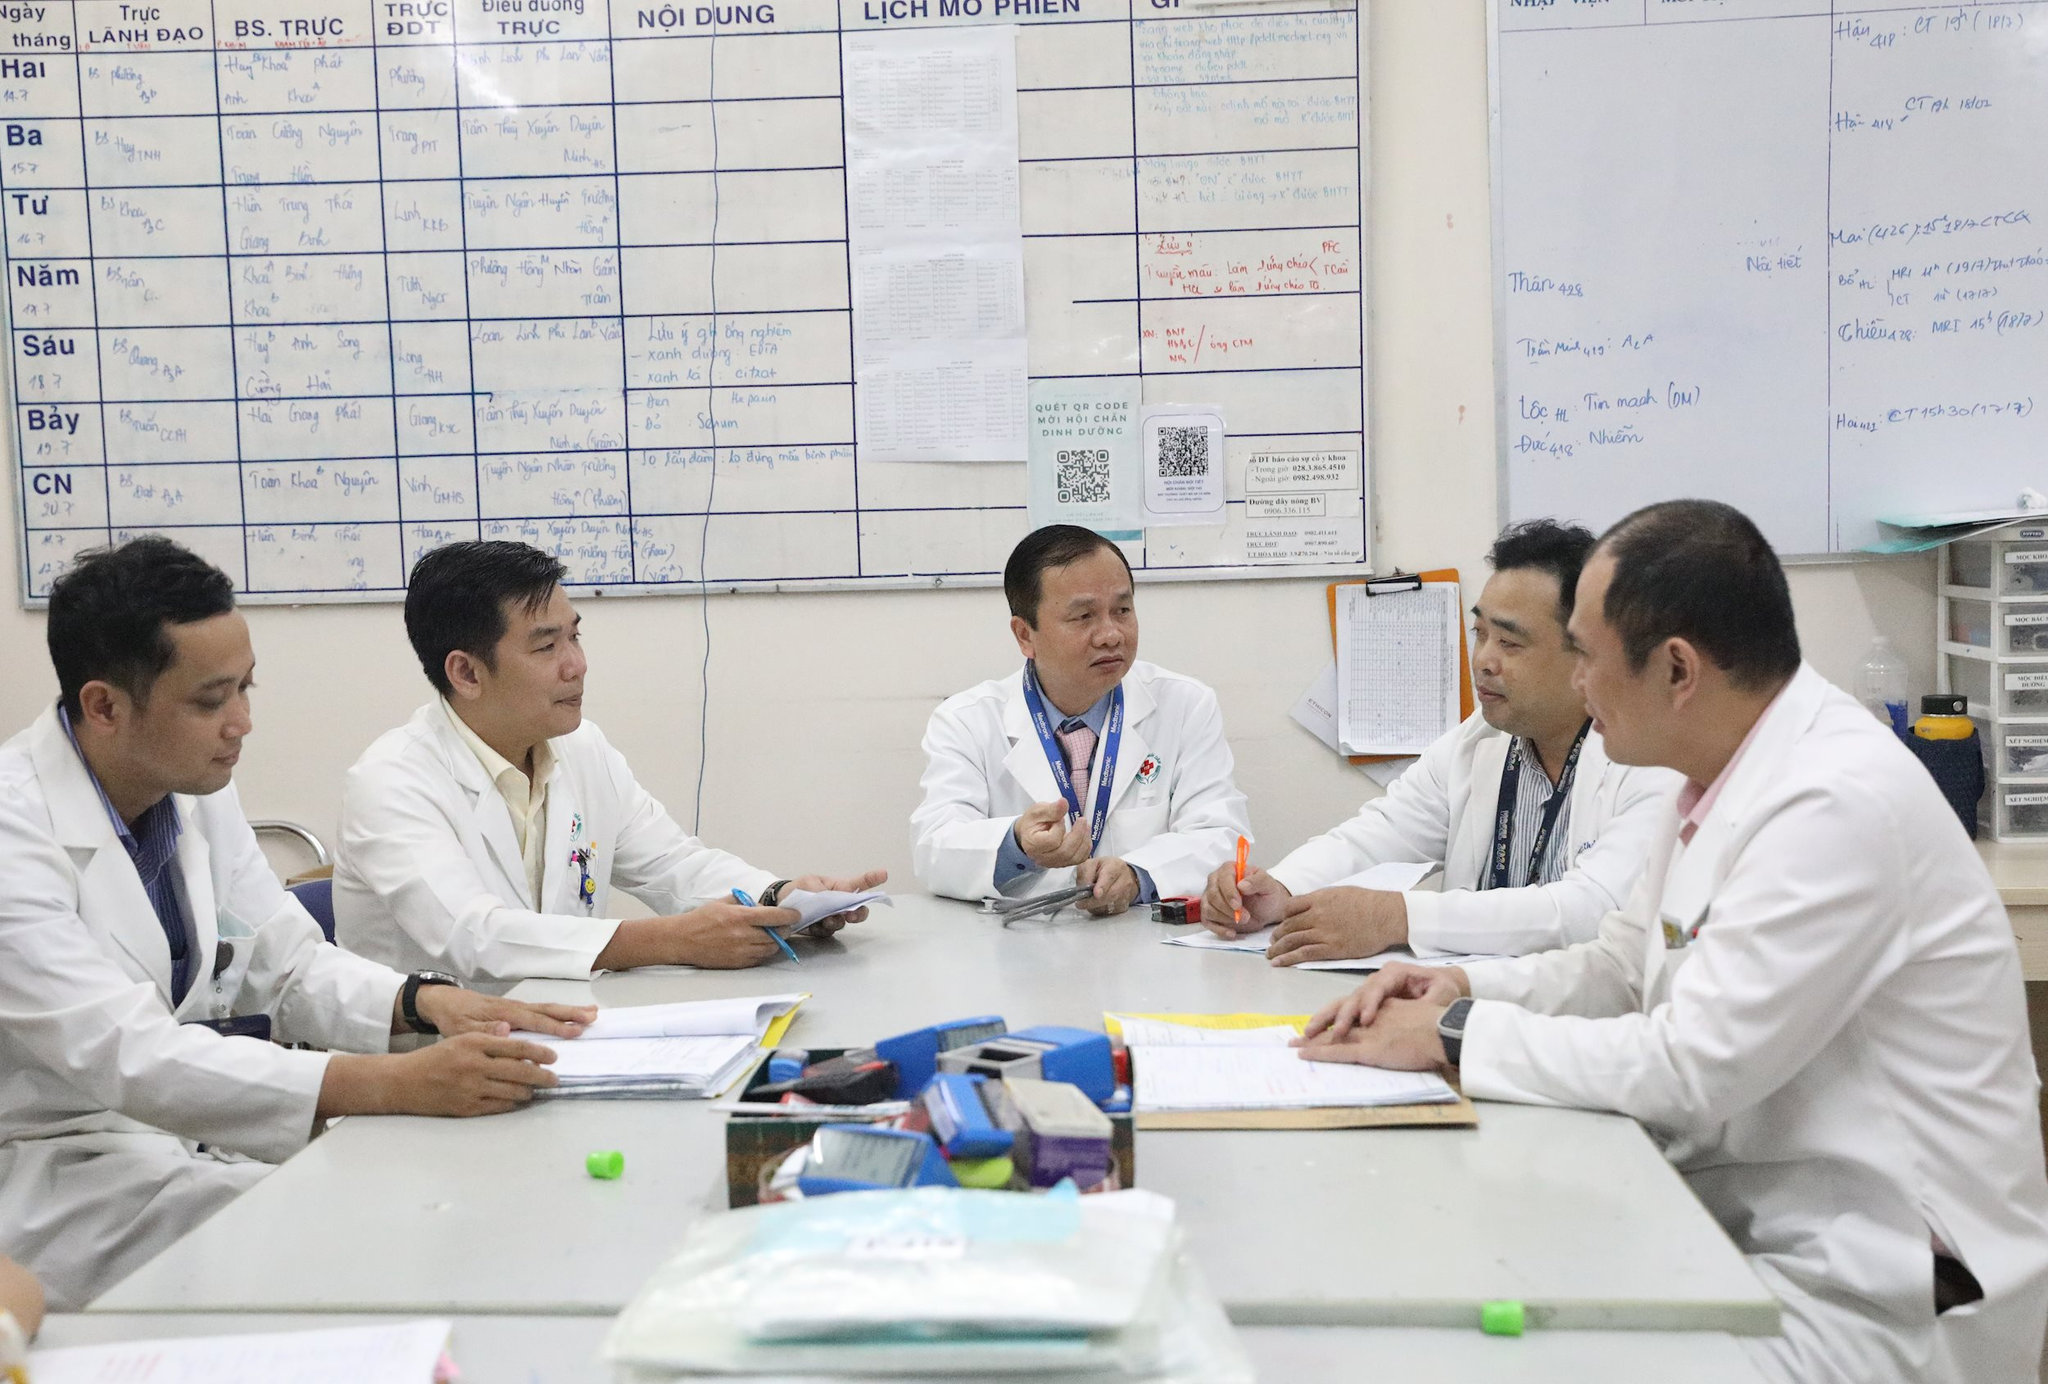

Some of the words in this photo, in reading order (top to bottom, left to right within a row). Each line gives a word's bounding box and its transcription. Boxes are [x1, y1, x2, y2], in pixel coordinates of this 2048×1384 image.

[119, 5, 161, 25] Trực
[384, 0, 448, 19] TRỰC
[638, 4, 685, 32] NỘI
[695, 4, 775, 26] DUNG
[864, 0, 928, 23] LỊCH
[89, 27, 149, 43] LÃNH
[157, 27, 204, 44] ĐẠO
[235, 19, 272, 37] BS.
[280, 17, 343, 41] TRỰC
[387, 20, 441, 36] ĐDT
[497, 18, 561, 37] TRỰC
[13, 32, 71, 50] tháng
[1, 59, 46, 78] Hai
[6, 124, 43, 146] Ba
[12, 194, 48, 216] Tư
[17, 264, 80, 287] Năm
[23, 334, 75, 356] Sáu
[1073, 402, 1090, 412] QR
[1095, 401, 1129, 410] CODE
[27, 406, 80, 435] Bảy
[1042, 428, 1073, 437] DINH
[33, 473, 74, 496] CN
[1036, 711, 1050, 741] Medtronic
[1110, 702, 1120, 735] Medtronic
[1055, 759, 1070, 790] Medtronic
[1100, 755, 1113, 788] Medtronic
[1091, 809, 1103, 842] Medtronic
